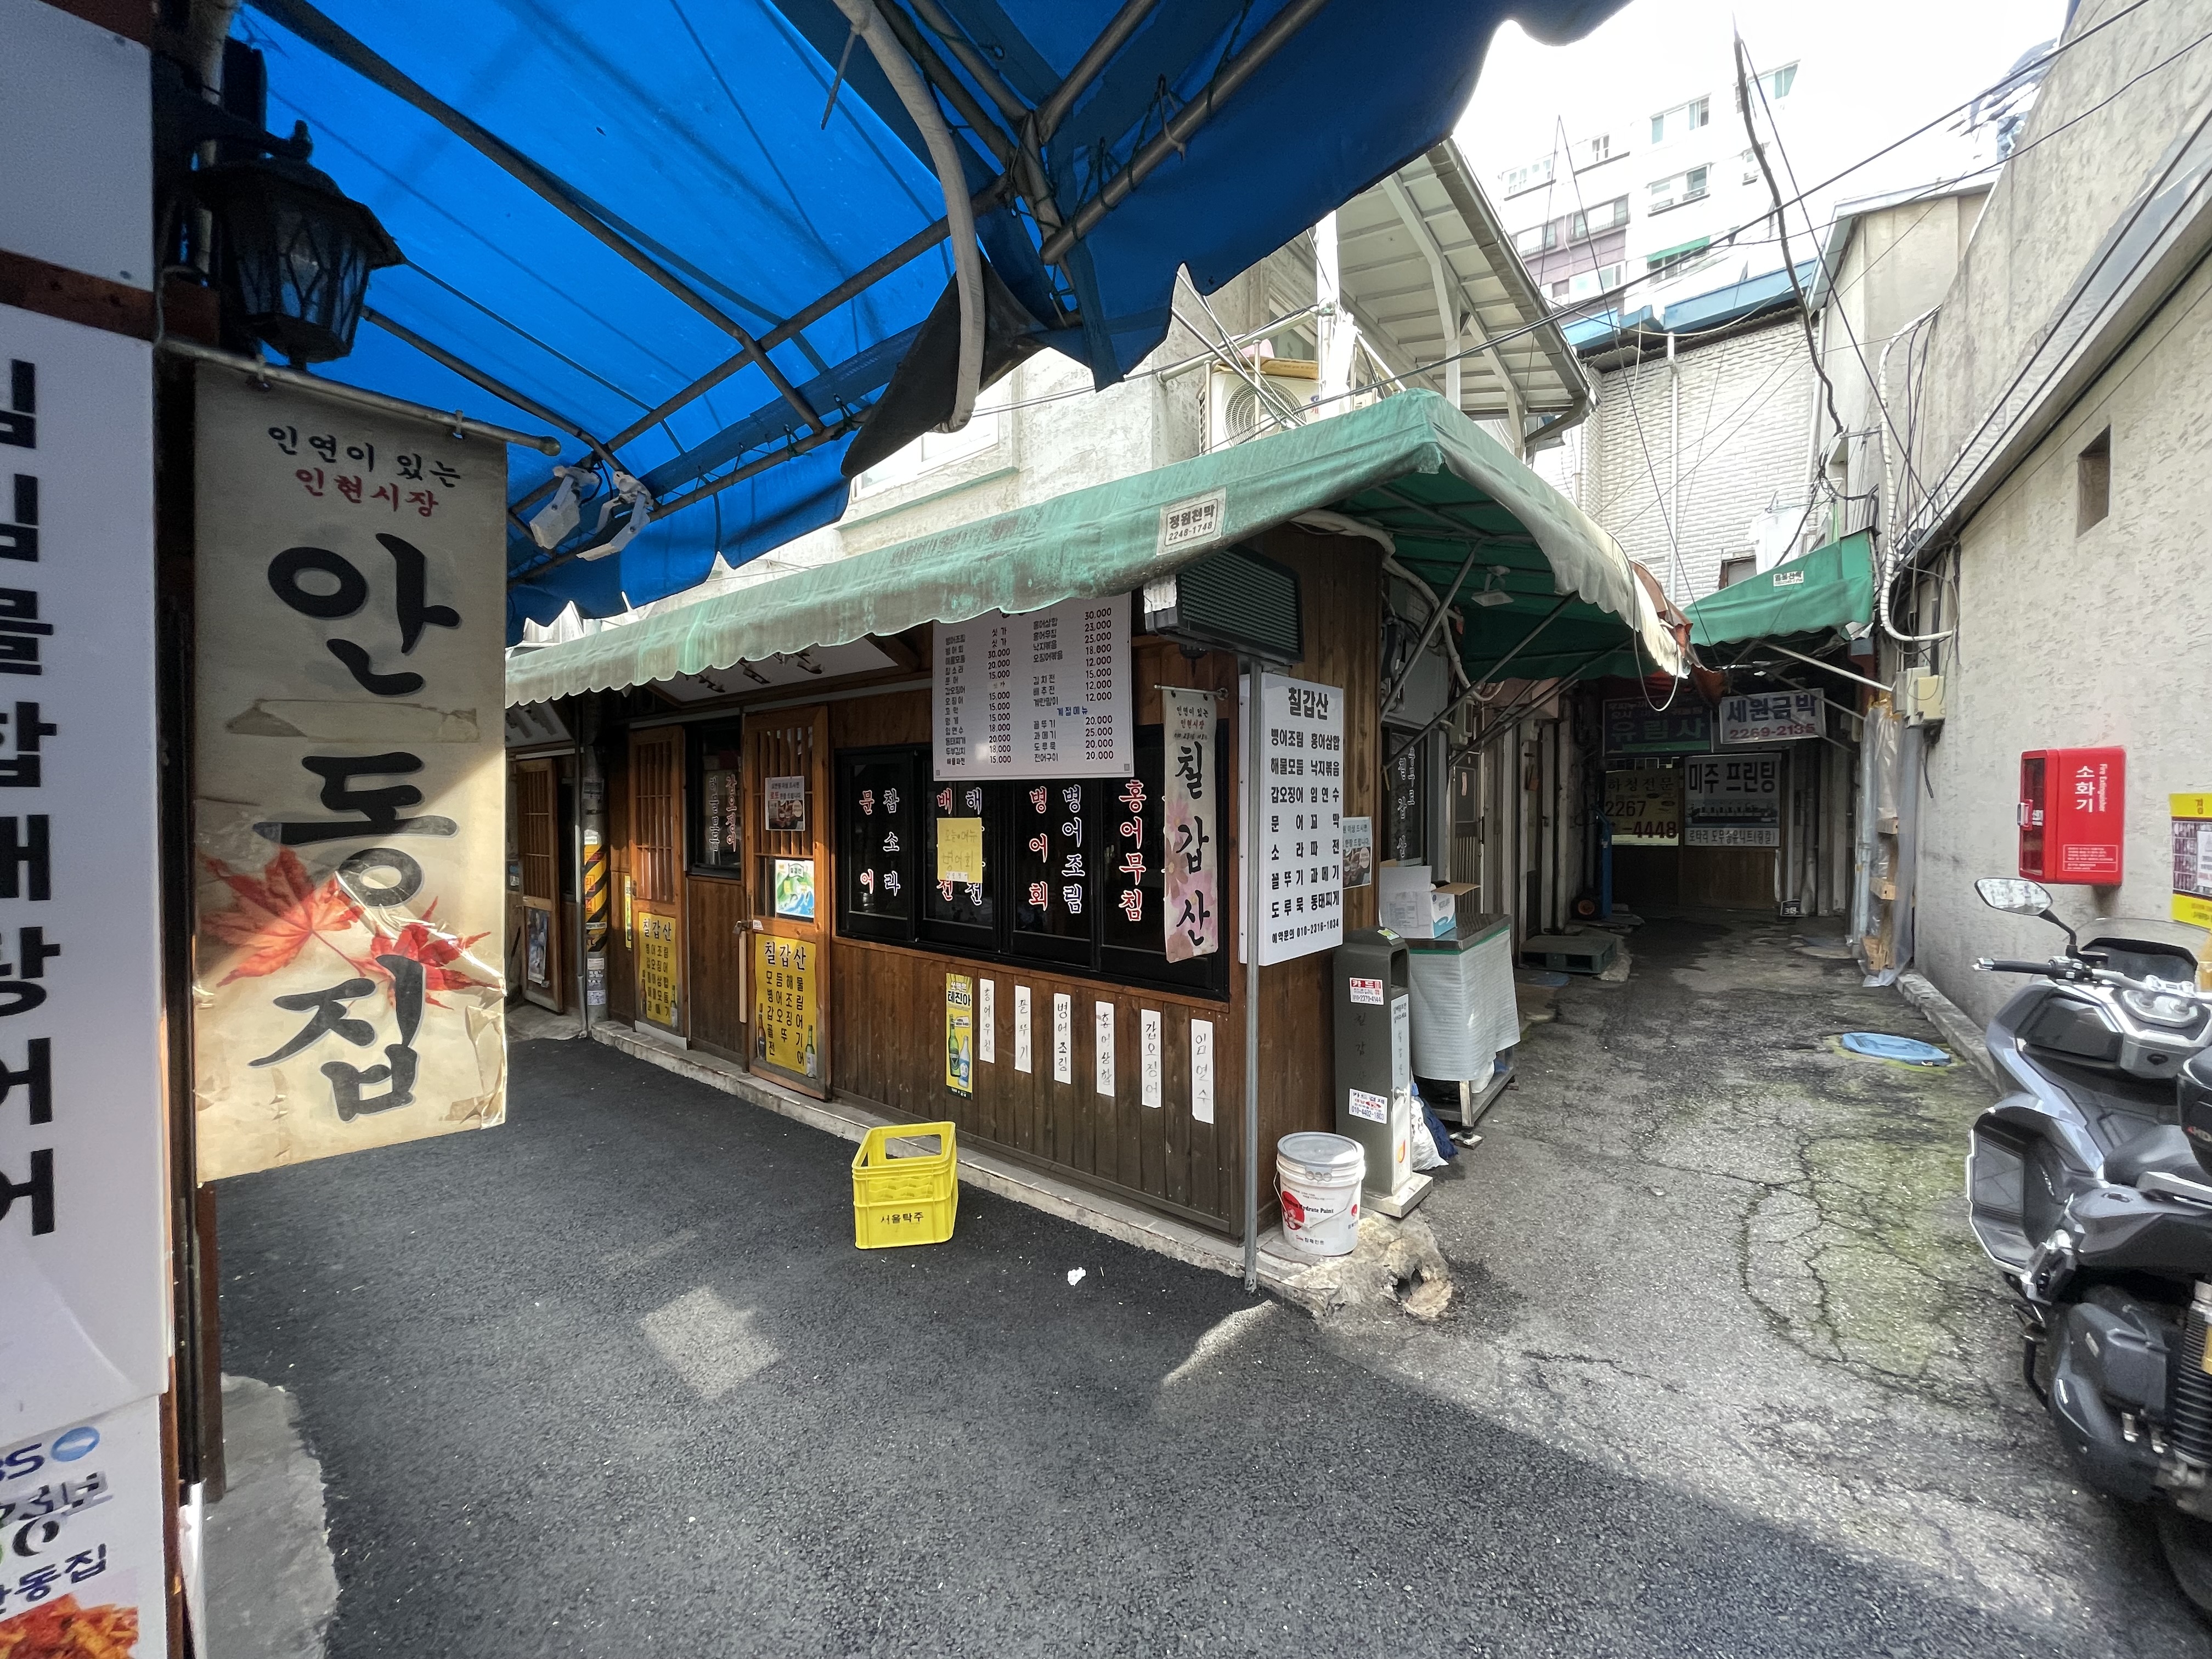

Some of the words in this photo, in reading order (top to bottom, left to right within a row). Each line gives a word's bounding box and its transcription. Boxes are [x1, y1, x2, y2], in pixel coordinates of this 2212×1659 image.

[268, 426, 375, 472] 인연이
[396, 453, 461, 488] 있는
[295, 467, 439, 517] 인현시장
[1169, 504, 1216, 530] 정원천막
[1168, 521, 1213, 541] 2248-1748
[1033, 617, 1058, 630] 홍어삼합
[1032, 640, 1058, 652] 낙지볶음
[1033, 650, 1063, 663] 오징어볶음
[945, 685, 966, 696] 갑오징어
[1032, 674, 1056, 685] 김치전
[945, 696, 963, 706] 오징어
[1033, 696, 1059, 707] 계란말이
[1288, 687, 1329, 720] 칠갑산
[1728, 694, 1817, 723] 세원금박
[946, 747, 966, 755] 두부김치
[1271, 728, 1304, 748] 병어조림
[1310, 732, 1340, 751] 홍어삼합
[1034, 752, 1059, 763] 전어구이
[1271, 757, 1304, 776] 해물모듬
[1310, 759, 1340, 777] 낙지볶음
[2098, 763, 2108, 775] Fire
[1689, 763, 1719, 794] 미주
[1726, 761, 1775, 793] 프린팅
[2074, 765, 2096, 813] 소화기
[1271, 786, 1304, 804] 갑오징어
[1310, 786, 1340, 803] 임연수
[2097, 776, 2108, 812] Extinguisher
[725, 774, 738, 853] 갑오징어
[1605, 800, 1646, 817] 2267
[247, 532, 462, 1122] 안동집
[1689, 830, 1708, 844] 로타리
[882, 787, 900, 897] 참소라
[936, 787, 954, 901] 배전
[964, 786, 983, 906] 해전
[1028, 785, 1048, 912] 병어회
[1062, 783, 1085, 915] 병어조림
[1118, 778, 1147, 922] 홍어무침
[1175, 741, 1210, 946] 칠갑산
[1271, 869, 1304, 890] 꼴뚜기
[1310, 864, 1340, 884] 과메기
[1271, 896, 1304, 919] 도루묵
[642, 917, 672, 942] 칠갑산
[1272, 928, 1295, 944] 예약문의
[1296, 918, 1340, 938] 010-2316-1034
[764, 940, 807, 972] 칠갑산
[947, 990, 972, 1007] 테진아
[1057, 1001, 1069, 1073] 병어조림
[1144, 1020, 1160, 1099] 갑오징어
[1194, 1032, 1213, 1104] 임연수
[880, 1211, 924, 1225] 서울탁주
